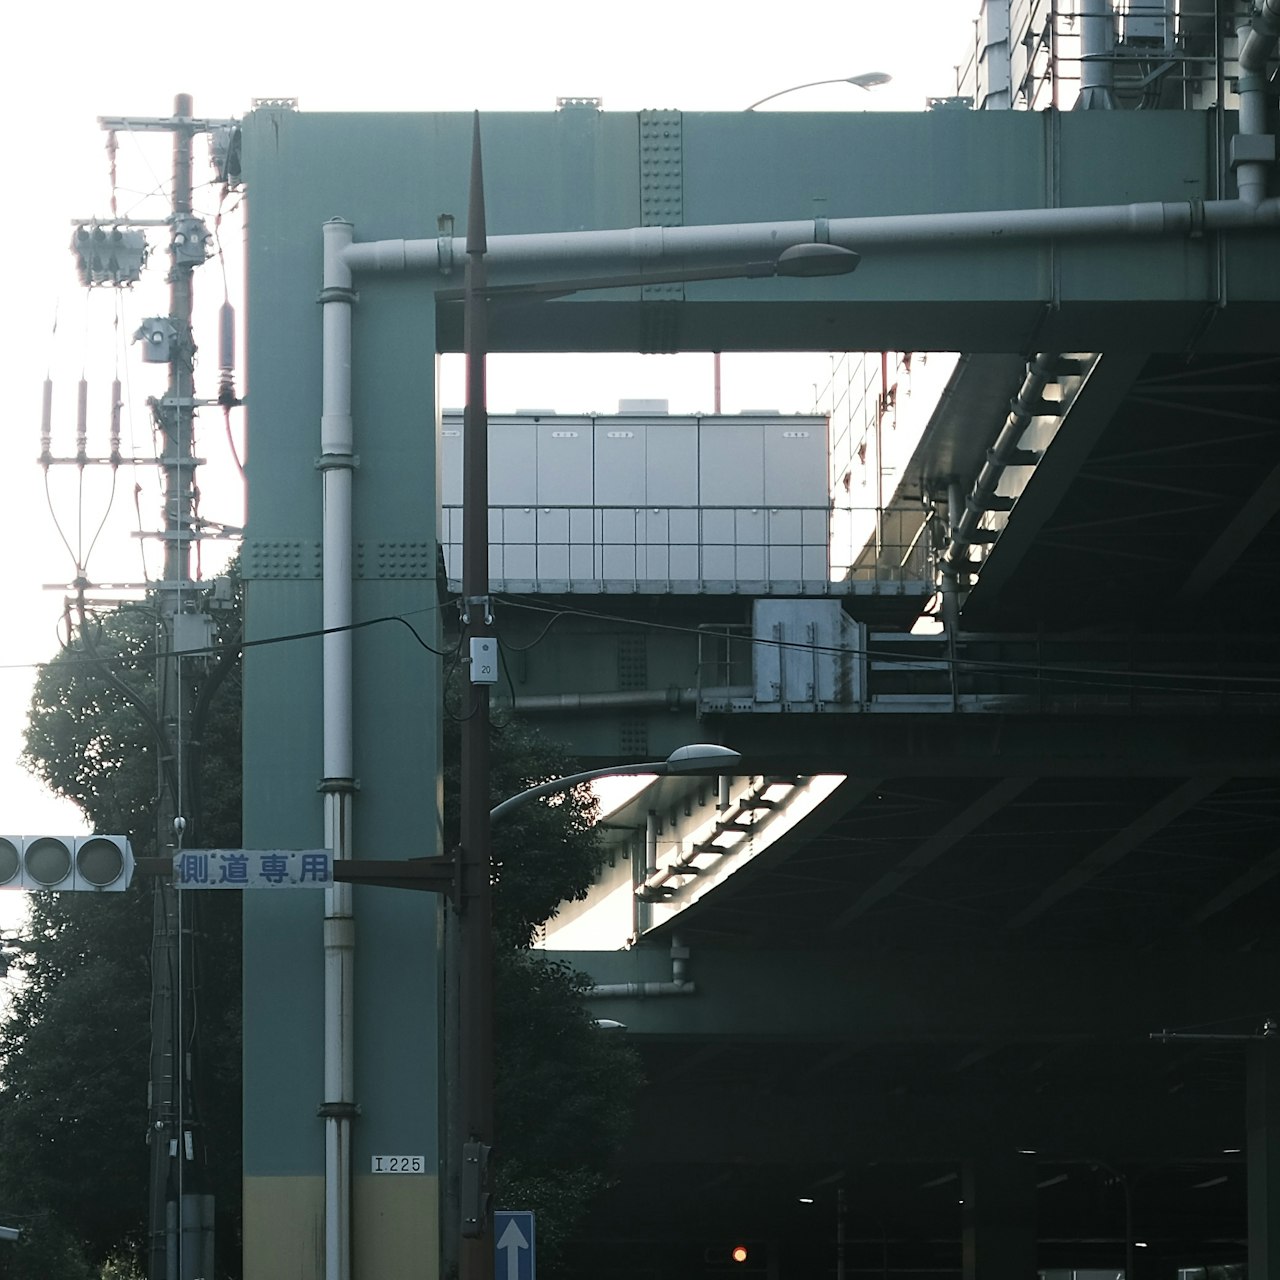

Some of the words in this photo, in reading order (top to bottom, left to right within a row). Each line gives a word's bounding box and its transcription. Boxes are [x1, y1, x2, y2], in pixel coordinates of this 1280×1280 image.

[481, 665, 491, 674] 20
[176, 853, 329, 884] 側道専用
